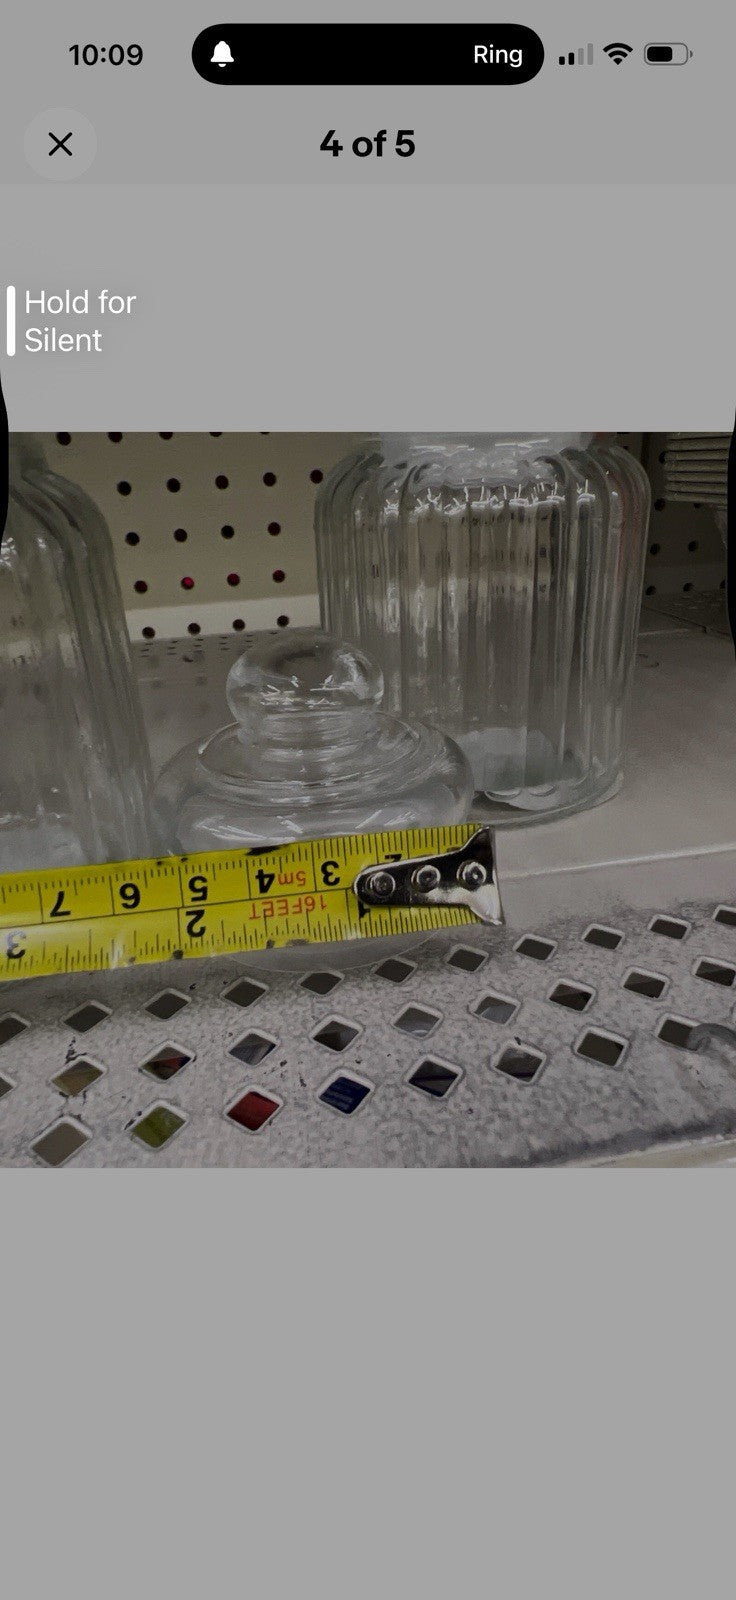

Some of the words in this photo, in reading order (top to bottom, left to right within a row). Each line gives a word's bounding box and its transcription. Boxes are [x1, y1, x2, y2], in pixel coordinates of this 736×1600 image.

[255, 869, 276, 894] 4
[277, 870, 306, 887] 5m
[321, 860, 341, 886] 3
[119, 883, 141, 909] 6
[188, 876, 208, 902] 5
[50, 891, 71, 917] 7
[248, 894, 328, 920] 16FEET
[185, 909, 206, 938] 2
[6, 930, 27, 959] 3
